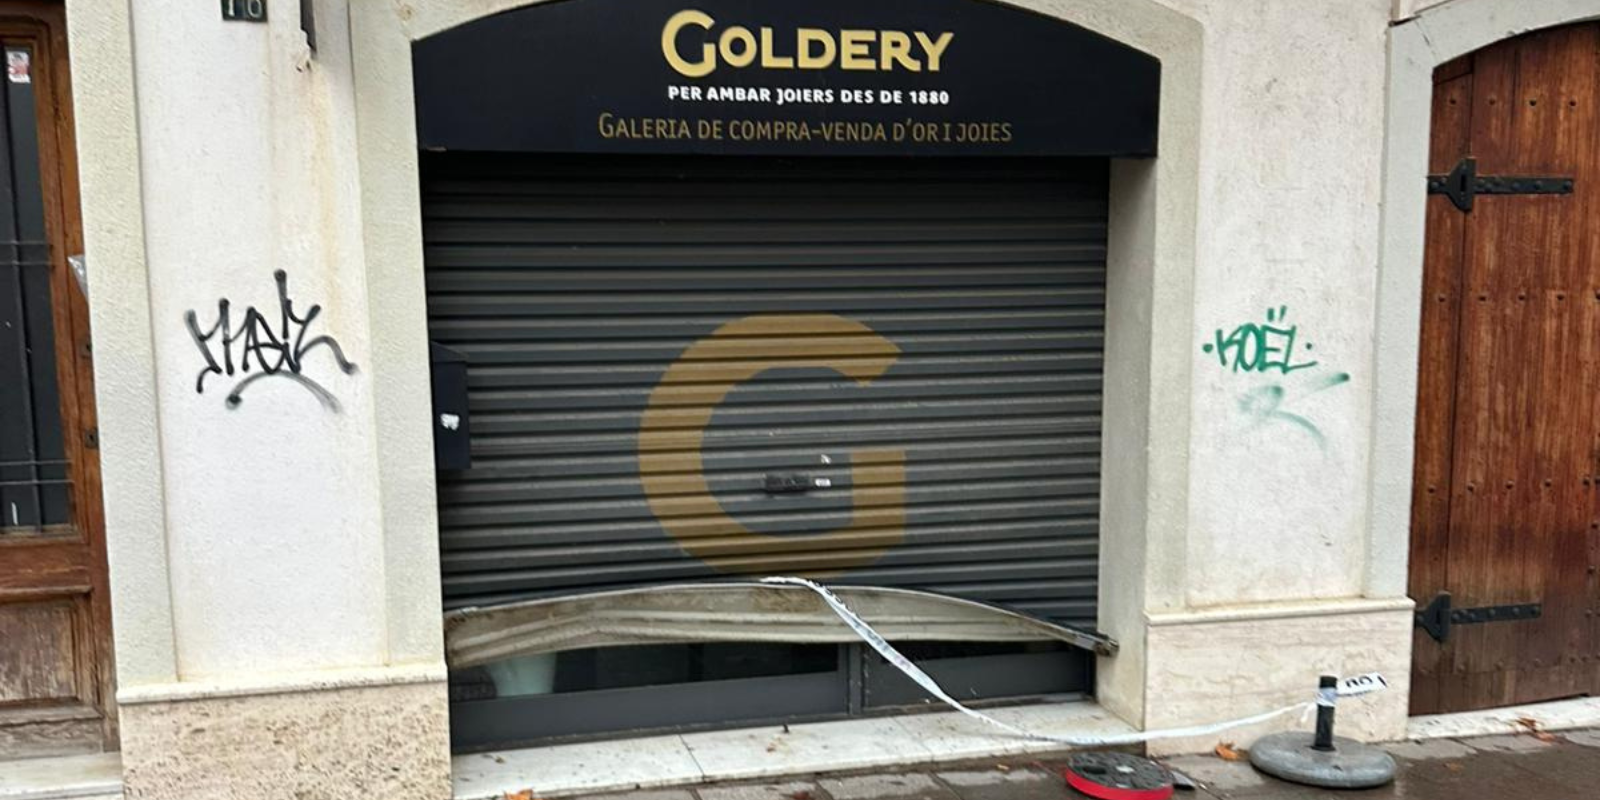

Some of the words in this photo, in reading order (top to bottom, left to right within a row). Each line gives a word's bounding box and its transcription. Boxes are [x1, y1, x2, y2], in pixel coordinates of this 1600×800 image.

[661, 9, 954, 77] GOLDERY
[667, 85, 702, 101] PER
[706, 86, 771, 102] AMBAR
[776, 88, 834, 105] JOIERS
[840, 89, 874, 104] DES
[880, 90, 902, 104] DE
[909, 90, 949, 105] 1880
[598, 112, 692, 139] GALERIA
[698, 119, 723, 139] DE
[729, 119, 887, 141] COMPRA-VENDA
[893, 118, 938, 142] D'OR
[943, 123, 951, 141] I
[956, 123, 1012, 142] JOIES
[638, 313, 906, 577] G
